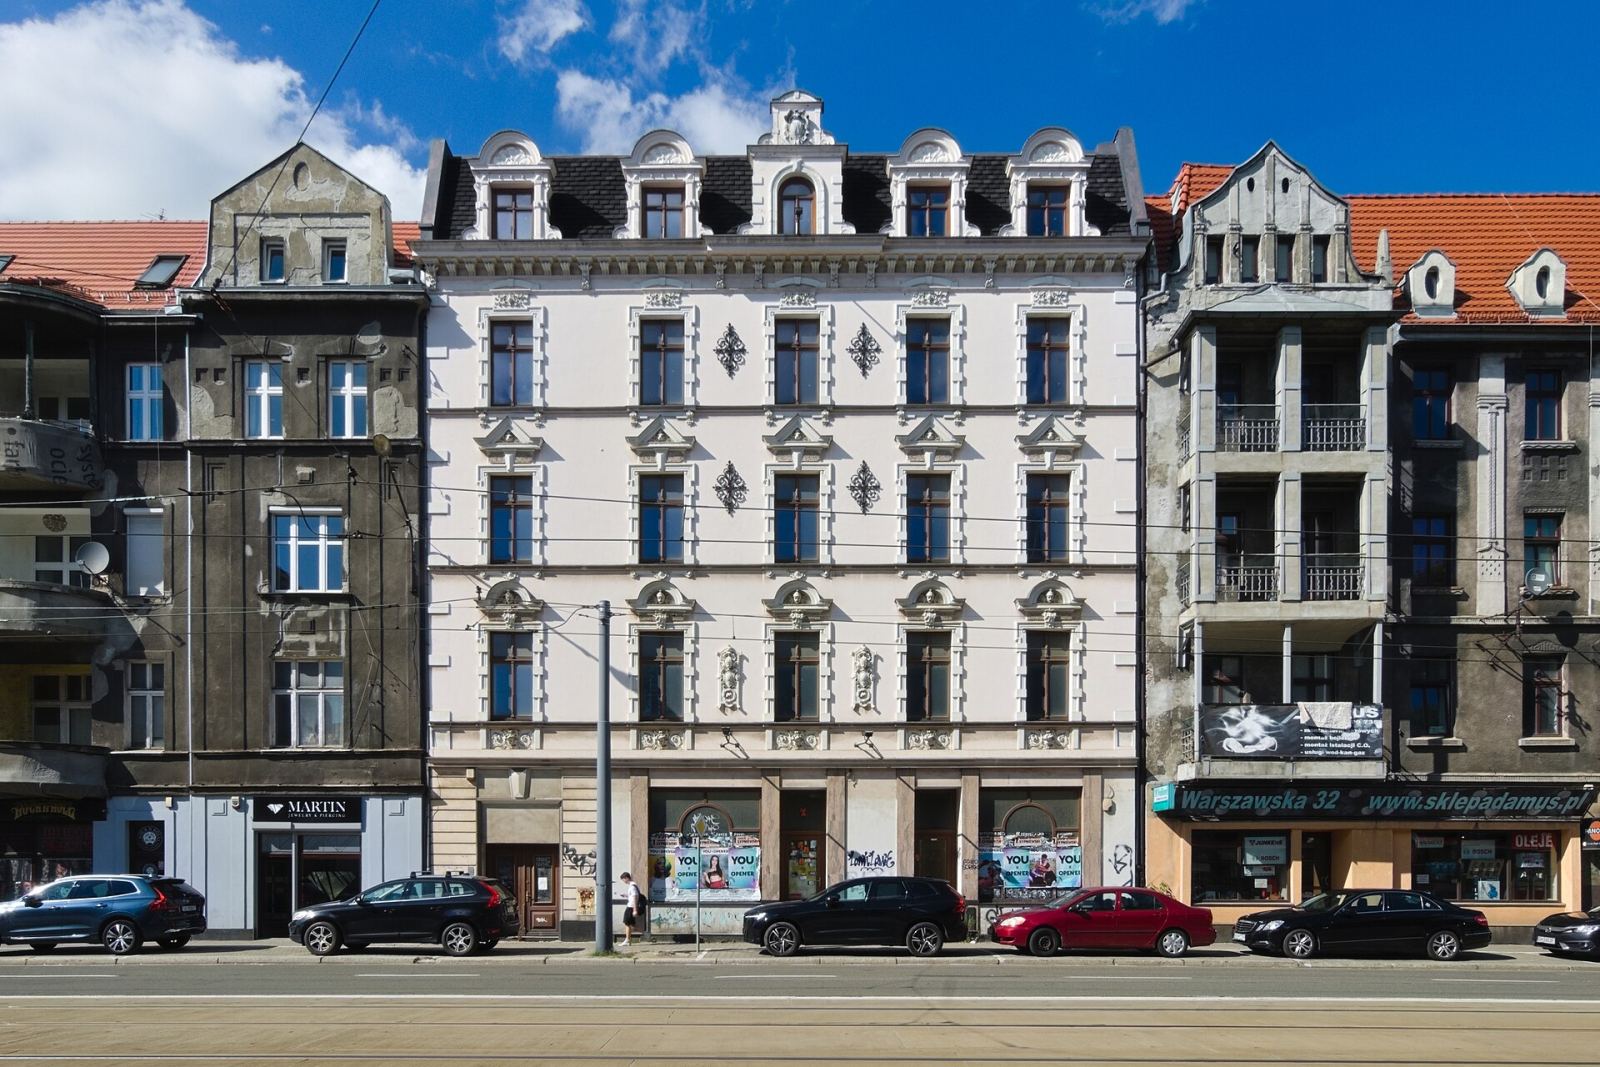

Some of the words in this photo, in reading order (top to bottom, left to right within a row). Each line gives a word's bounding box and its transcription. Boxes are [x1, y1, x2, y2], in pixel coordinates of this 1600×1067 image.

[288, 800, 346, 813] MARTIN
[1181, 790, 1308, 810] Warszawska
[1312, 790, 1341, 810] 32
[1367, 791, 1591, 814] www.sklepadamus.pl
[1515, 834, 1553, 848] OLEJE
[731, 856, 754, 865] YOU
[1006, 855, 1029, 864] YOU
[1058, 855, 1080, 864] YOU
